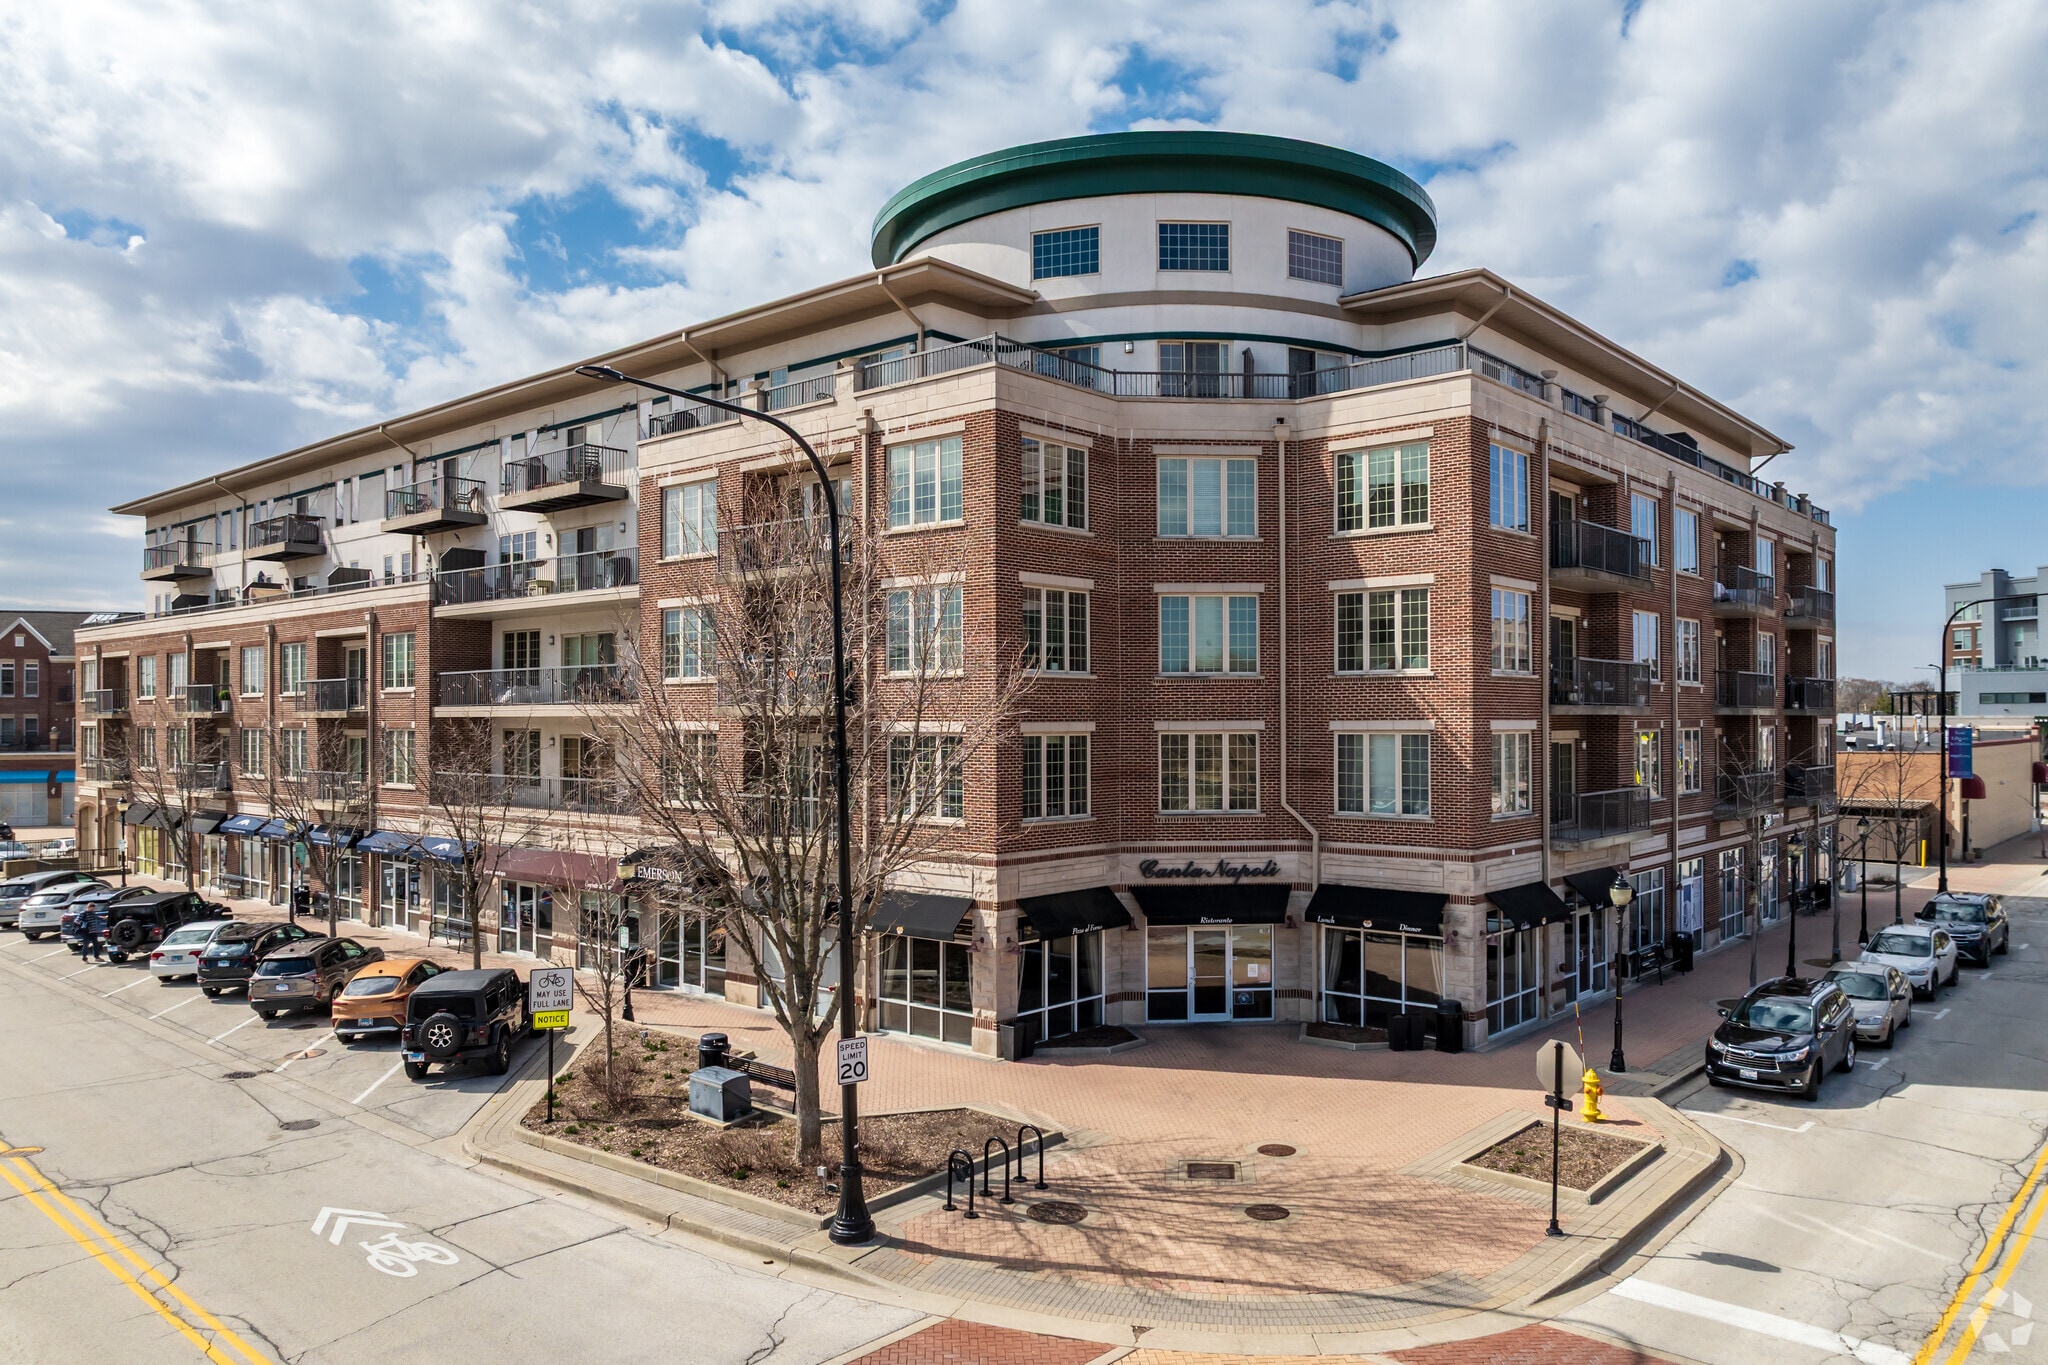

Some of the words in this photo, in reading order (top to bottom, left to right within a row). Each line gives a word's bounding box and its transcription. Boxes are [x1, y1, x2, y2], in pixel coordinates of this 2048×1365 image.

[1139, 859, 1206, 879] Canta
[1205, 859, 1281, 885] Napoli
[1200, 916, 1233, 924] Ristorante
[553, 989, 567, 997] USE
[553, 999, 570, 1007] LANE
[537, 1015, 565, 1023] NOTICE
[840, 1041, 865, 1051] SPEED
[842, 1051, 862, 1060] LIMIT
[840, 1061, 865, 1080] 20
